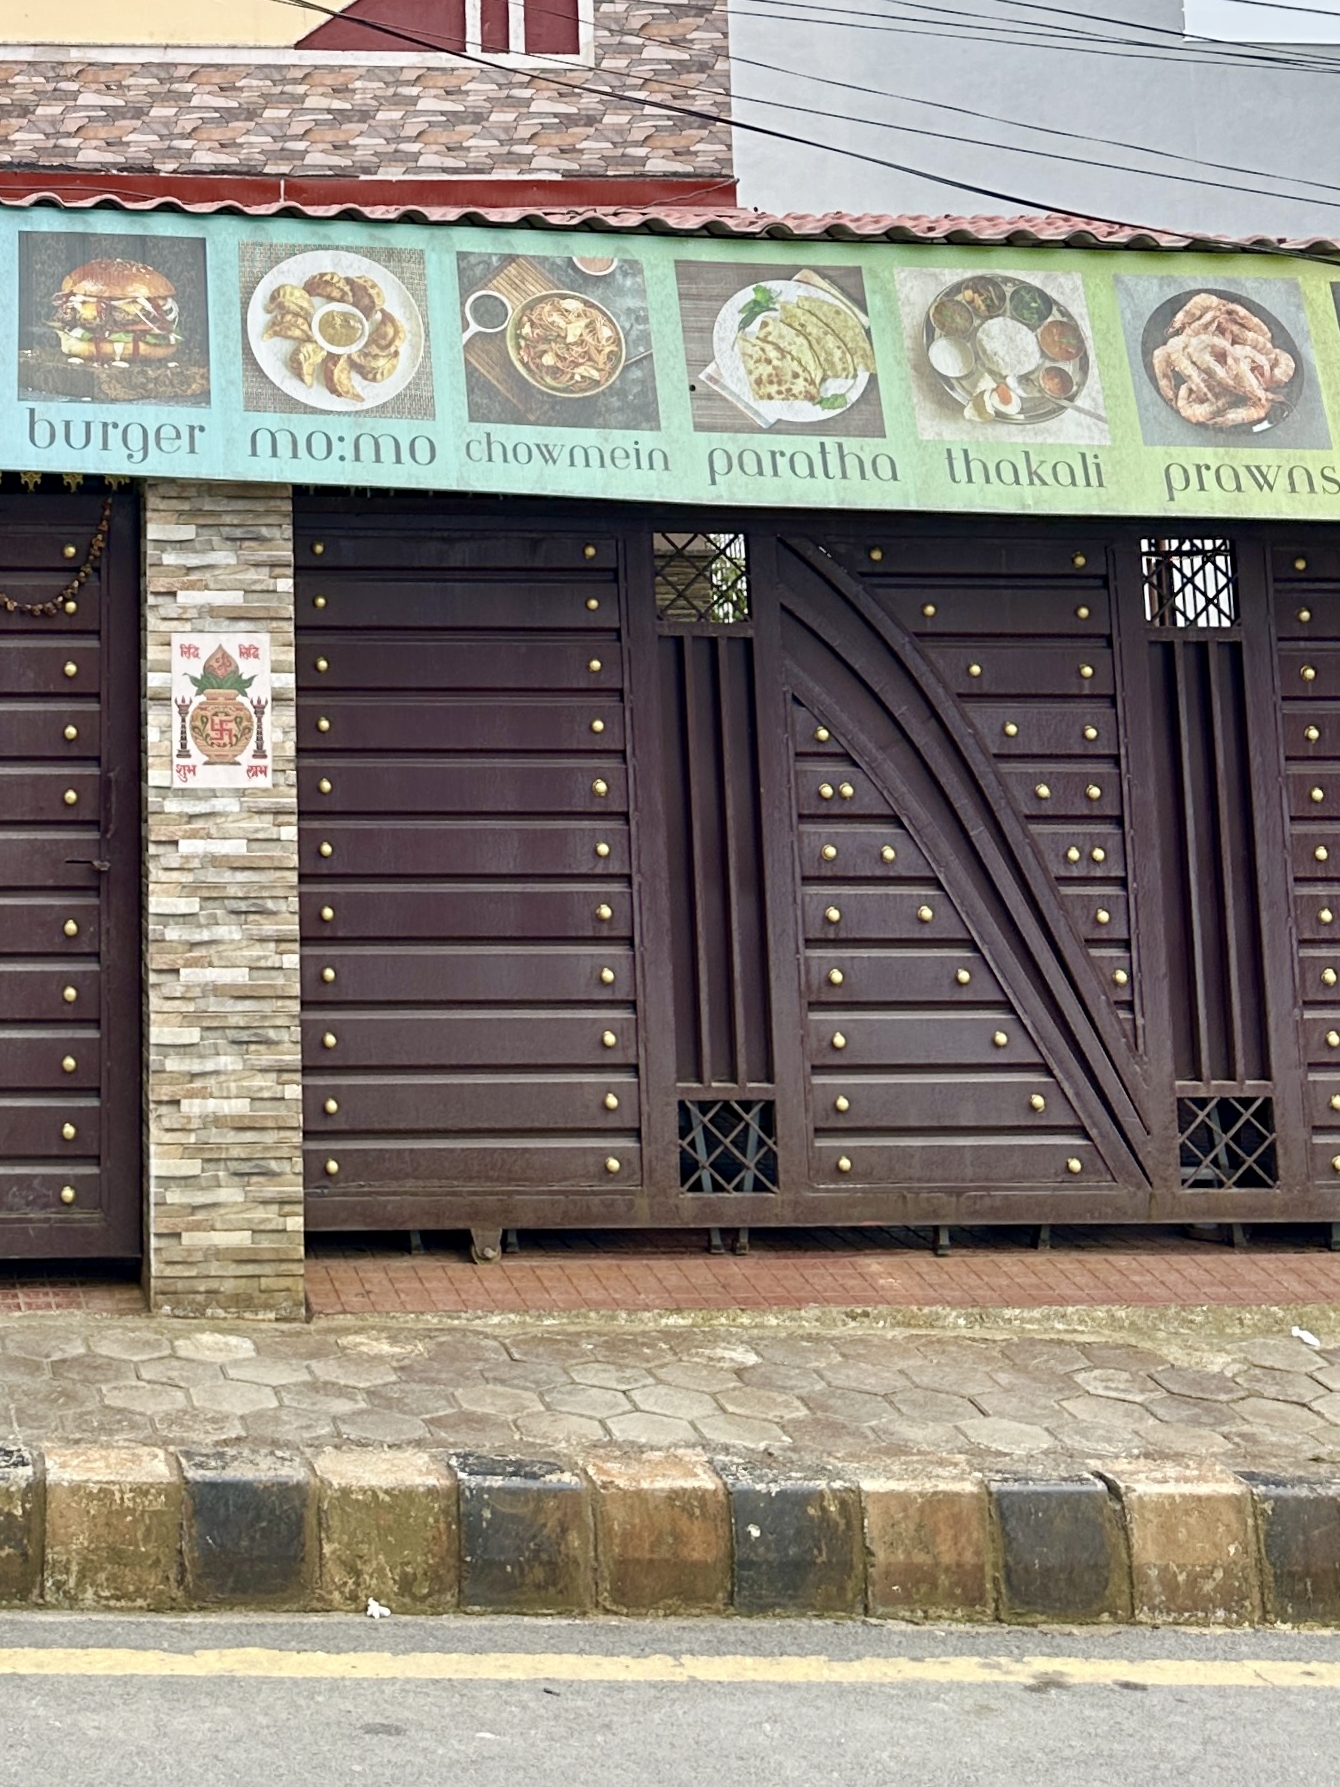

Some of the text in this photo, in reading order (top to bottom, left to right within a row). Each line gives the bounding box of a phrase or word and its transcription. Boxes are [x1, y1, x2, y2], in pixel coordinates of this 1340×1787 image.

[27, 408, 205, 463] burger
[248, 427, 438, 466] mo:mo
[465, 430, 673, 472] chowmein
[707, 441, 902, 486] paratha
[945, 446, 1108, 490] thakali
[1164, 462, 1340, 502] prawns
[176, 764, 197, 783] शुभ
